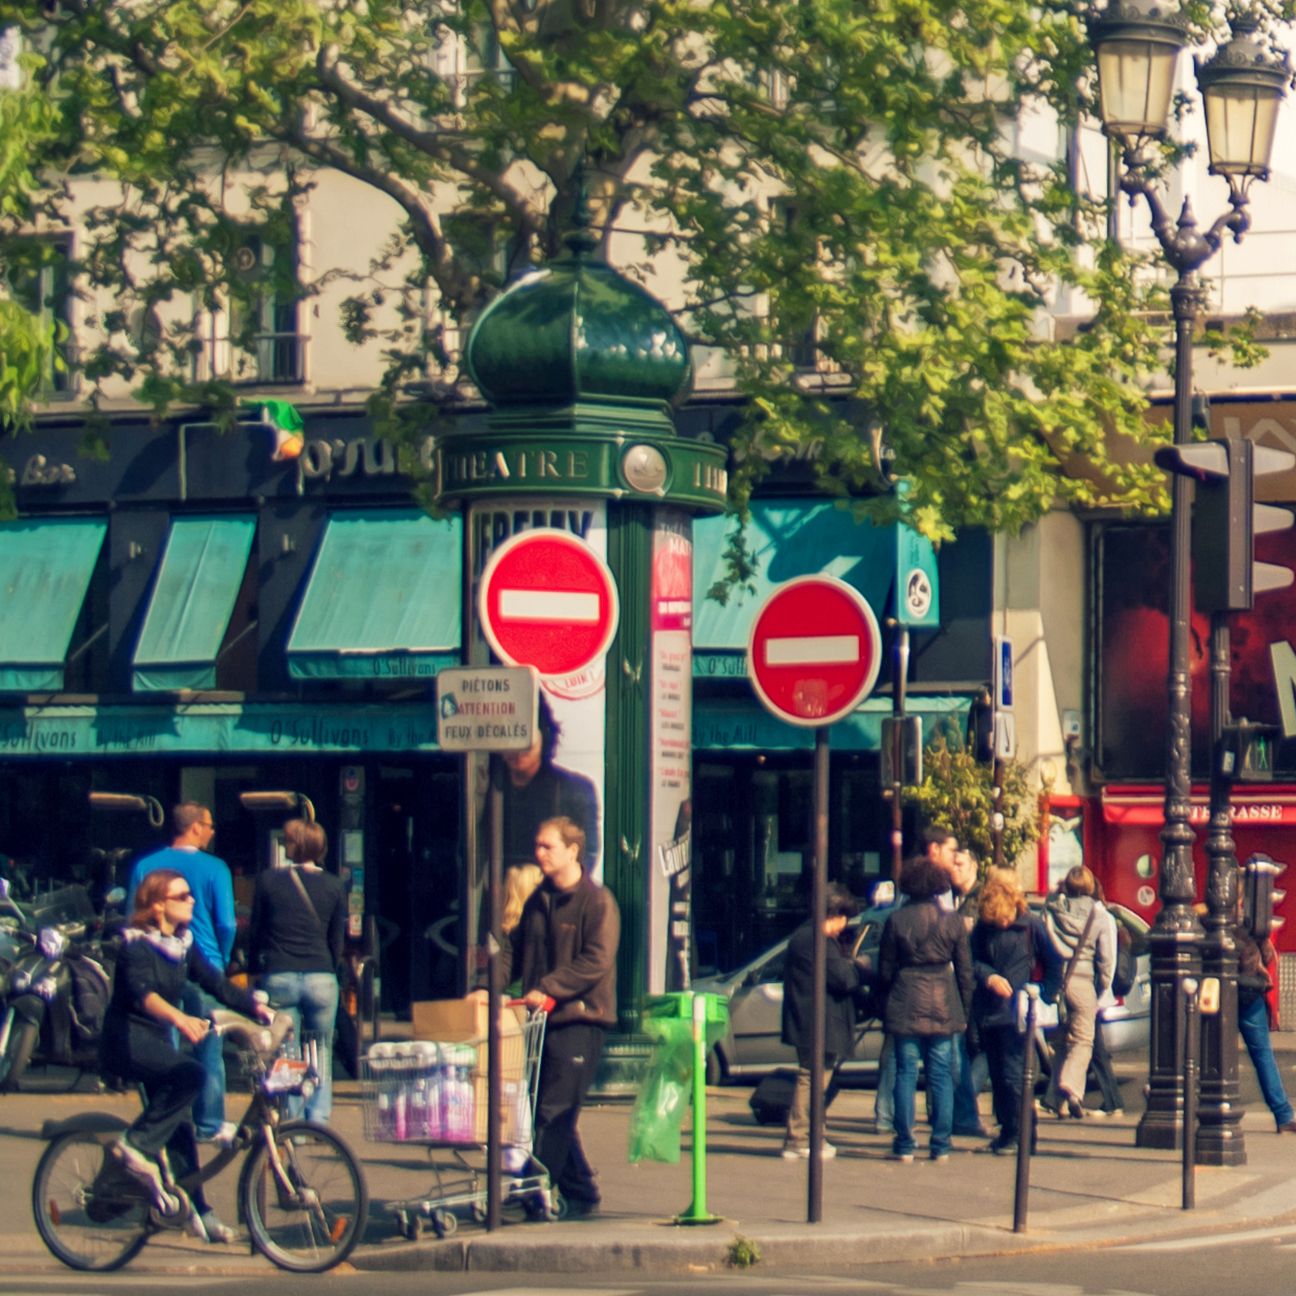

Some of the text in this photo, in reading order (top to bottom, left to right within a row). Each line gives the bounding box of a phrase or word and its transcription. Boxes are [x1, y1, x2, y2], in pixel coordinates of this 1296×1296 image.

[462, 676, 511, 692] PIÉTONS
[457, 702, 516, 716] ATTENTION
[445, 725, 472, 739] FEUX
[478, 722, 528, 739] DÉCALÉS
[1188, 804, 1284, 820] TERASSE
